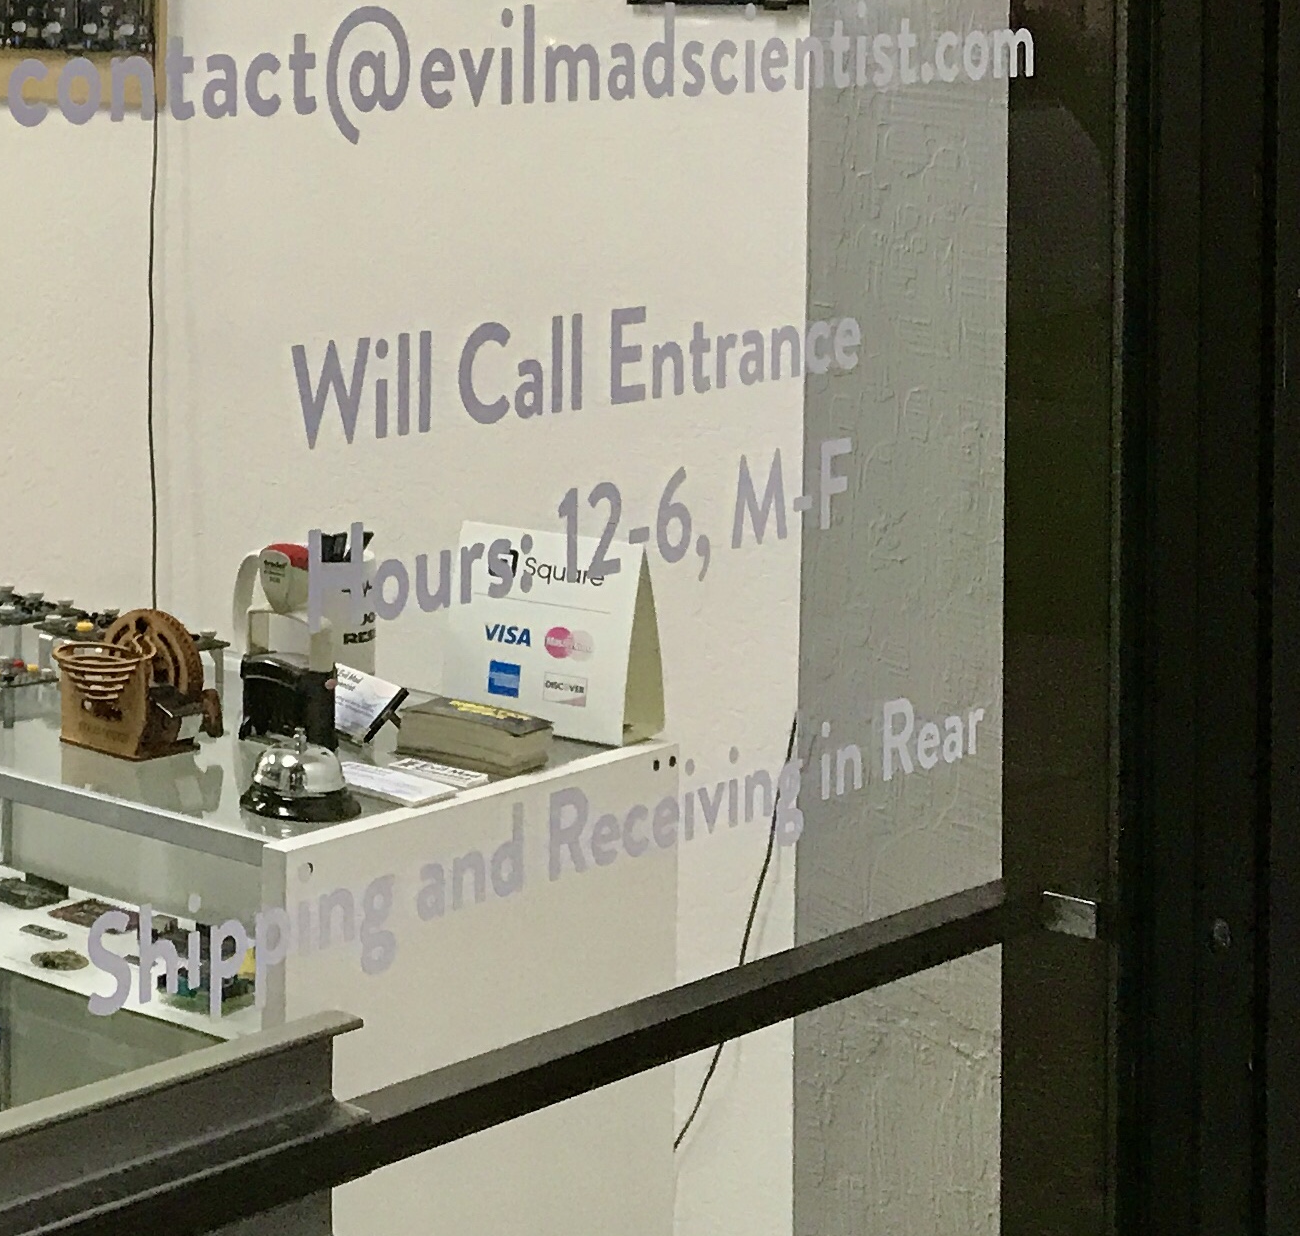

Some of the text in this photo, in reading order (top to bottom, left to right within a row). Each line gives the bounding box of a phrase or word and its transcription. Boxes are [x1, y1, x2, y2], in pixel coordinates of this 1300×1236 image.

[8, 5, 1034, 144] contact@evilmadscientist.com
[291, 307, 861, 449] Will Call Entrance
[308, 438, 853, 633] Hours: 12-6, M-F
[485, 624, 531, 647] VISA
[88, 698, 984, 1022] Shipping and Receiving in Rear
